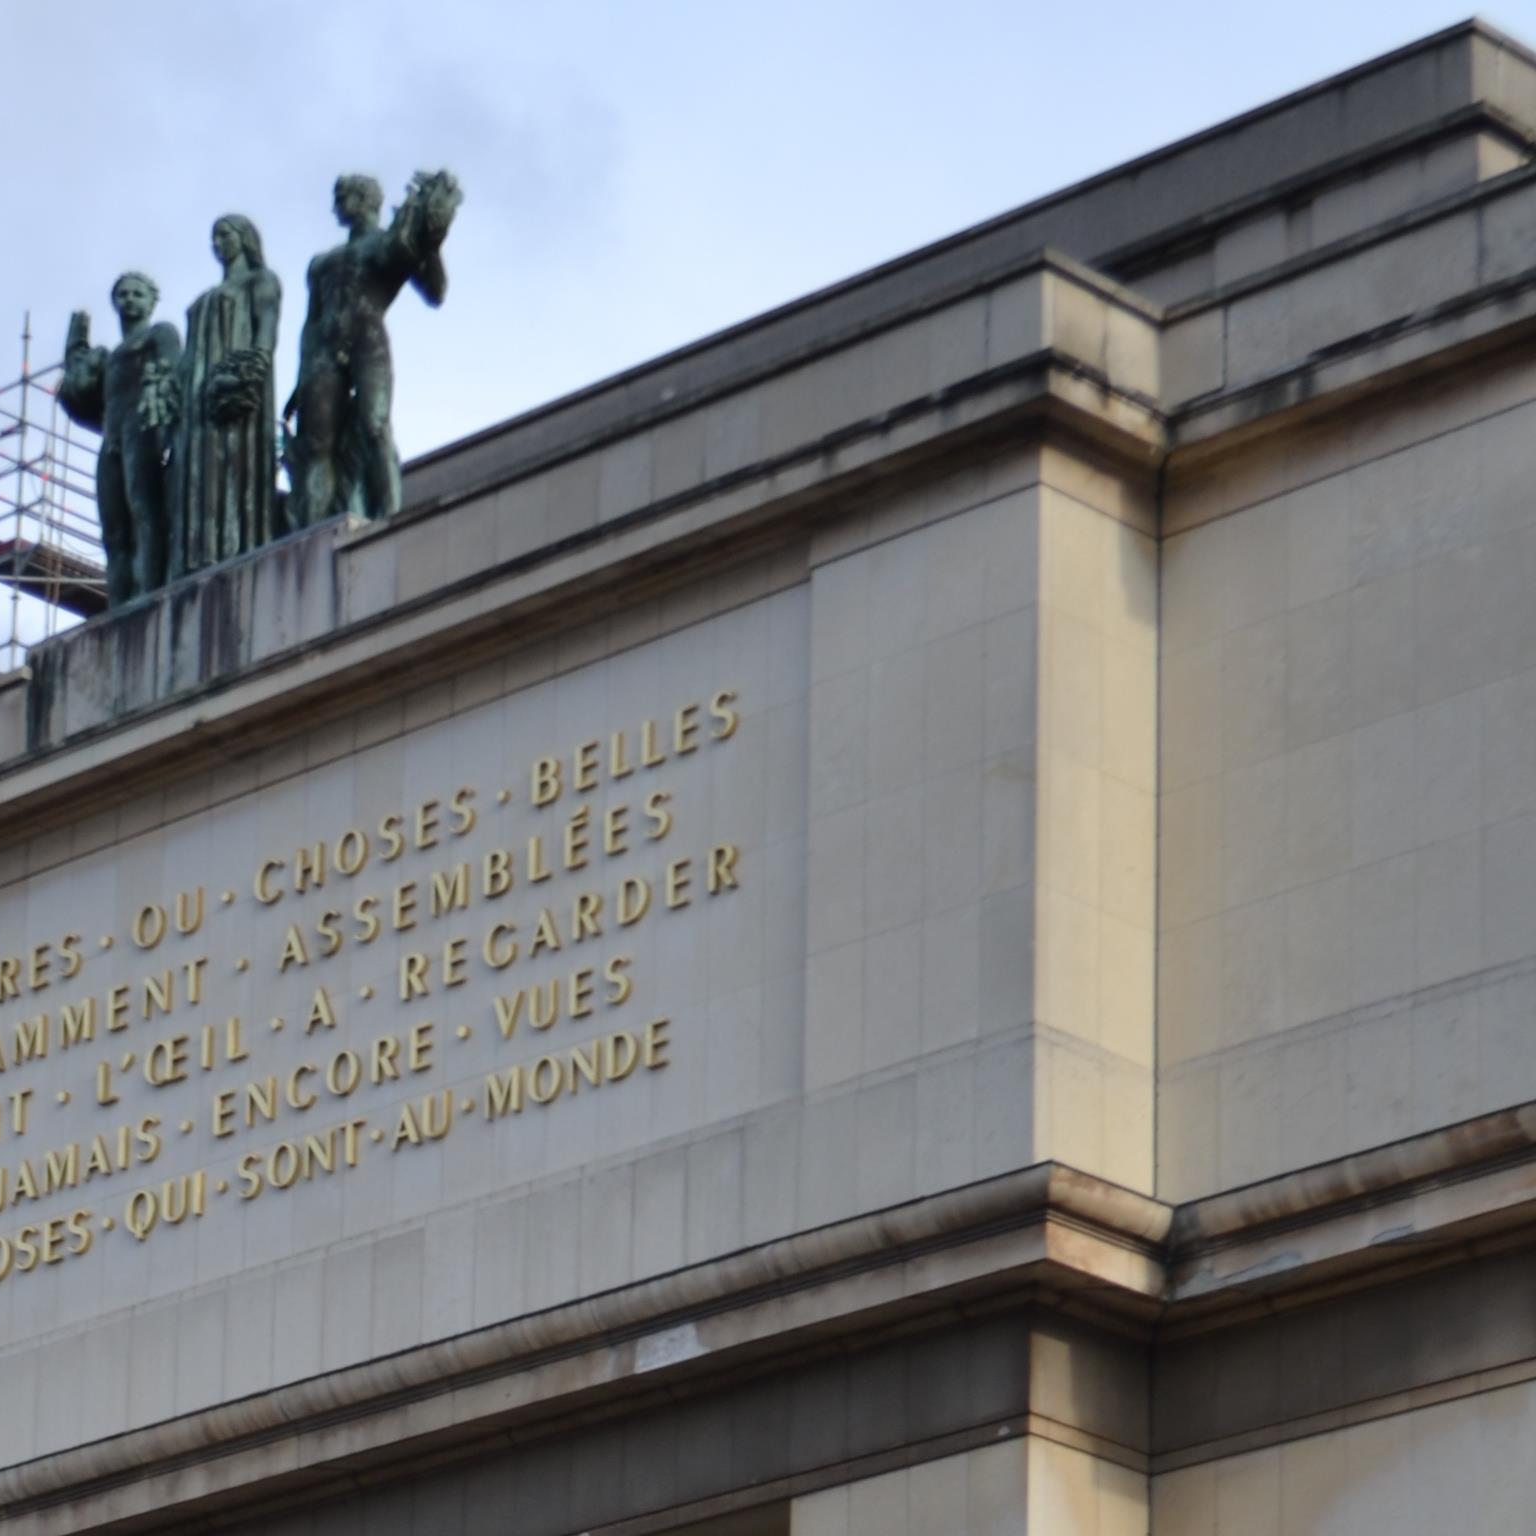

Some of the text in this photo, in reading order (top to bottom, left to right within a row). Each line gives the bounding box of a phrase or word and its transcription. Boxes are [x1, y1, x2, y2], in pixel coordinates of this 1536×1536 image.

[132, 886, 205, 950] OU
[254, 785, 478, 906] CHOSES
[530, 689, 742, 811] BELLES
[277, 791, 675, 974] ASSEMBLÉES
[304, 985, 337, 1036] A
[399, 841, 742, 1003] REGARDER
[124, 1169, 207, 1241] QUI
[236, 1117, 366, 1201] SONT
[390, 1088, 454, 1154] AU
[482, 1016, 672, 1121] MONDE
[211, 1022, 435, 1139] ENCORE
[492, 954, 634, 1040] VUES
